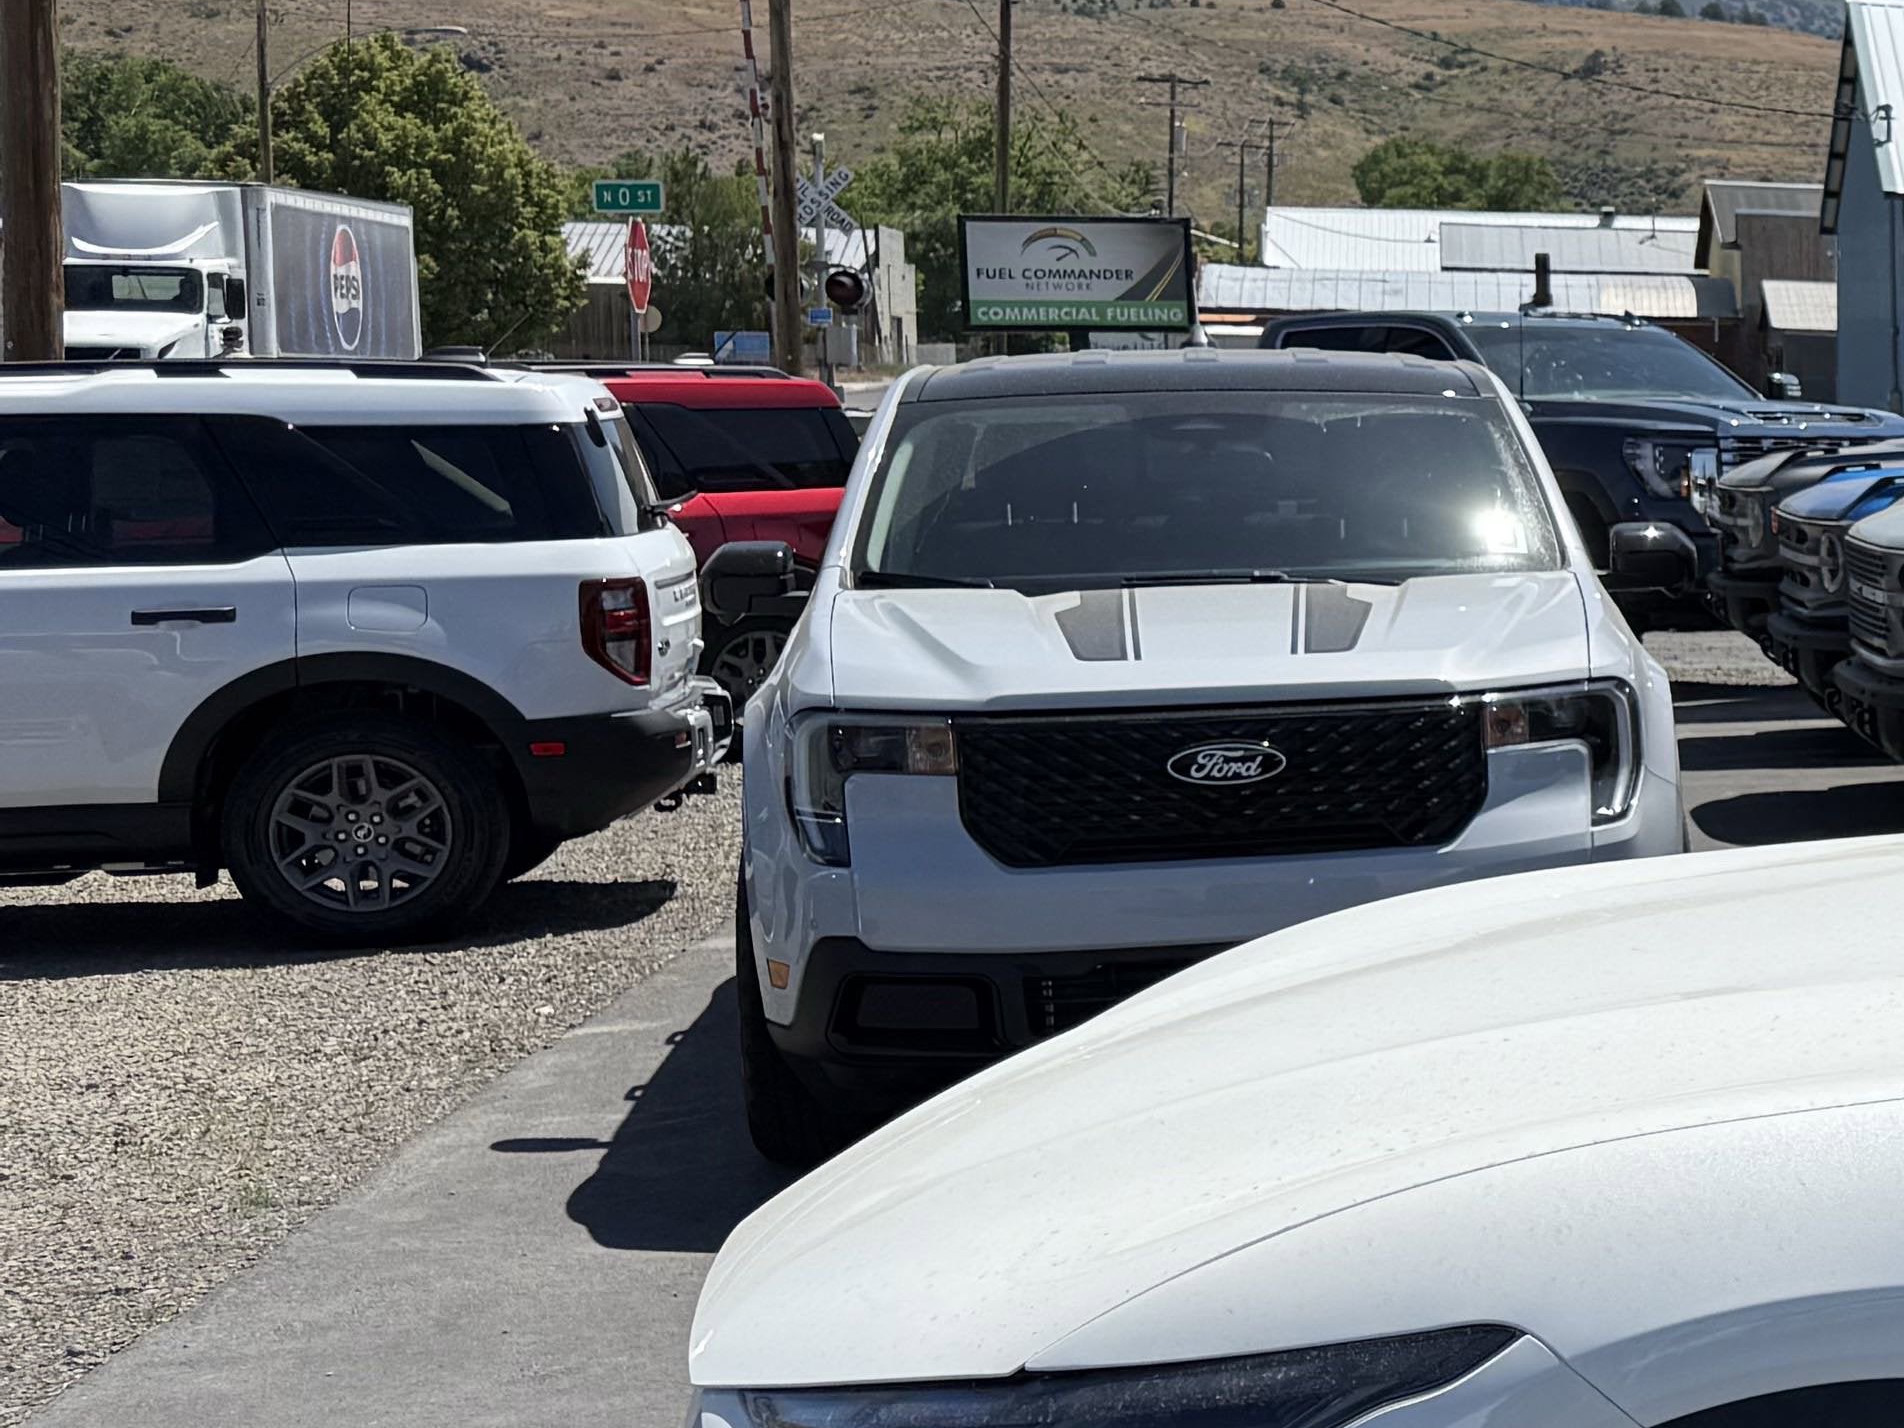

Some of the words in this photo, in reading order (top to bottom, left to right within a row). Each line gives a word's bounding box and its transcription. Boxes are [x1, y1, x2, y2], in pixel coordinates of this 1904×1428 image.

[603, 190, 612, 203] N
[637, 190, 653, 203] ST
[799, 170, 849, 222] OSSING
[824, 205, 854, 233] ROAD
[627, 247, 650, 283] STOP
[976, 267, 1016, 280] FUEL
[1021, 267, 1134, 281] COMMANDER
[1025, 282, 1093, 292] NETWORK
[976, 306, 1100, 321] COMMERCIAL
[1106, 307, 1183, 322] FUELING
[1190, 750, 1264, 778] Ford
